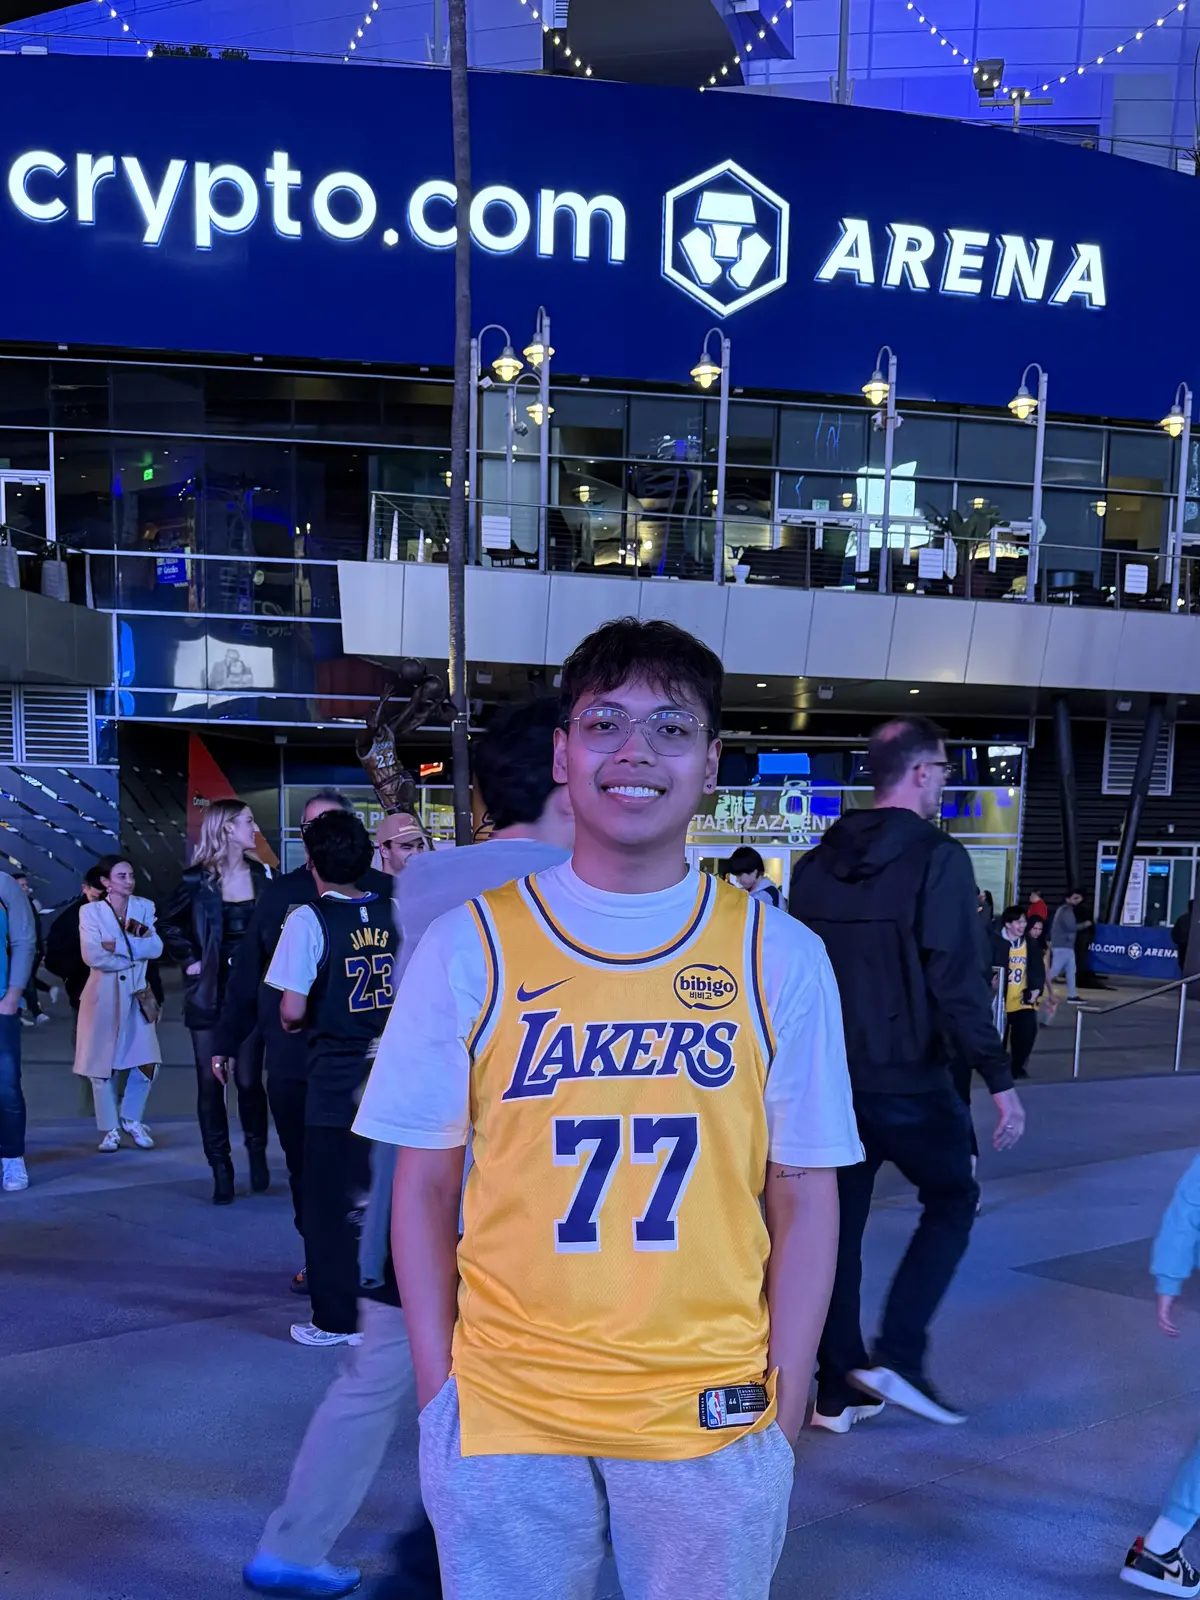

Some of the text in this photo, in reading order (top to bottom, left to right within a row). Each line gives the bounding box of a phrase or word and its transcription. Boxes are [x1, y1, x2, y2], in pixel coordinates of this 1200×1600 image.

[8, 150, 1108, 309] crypto.com ARENA
[376, 751, 395, 769] 22
[735, 814, 795, 830] PLAZA
[350, 927, 389, 951] JAMES
[1144, 947, 1178, 959] ARENA
[345, 953, 396, 1013] 23
[680, 975, 734, 997] bibigo
[689, 991, 712, 1000] 비비고
[501, 1008, 740, 1102] LAKERS
[552, 1113, 701, 1254] 77
